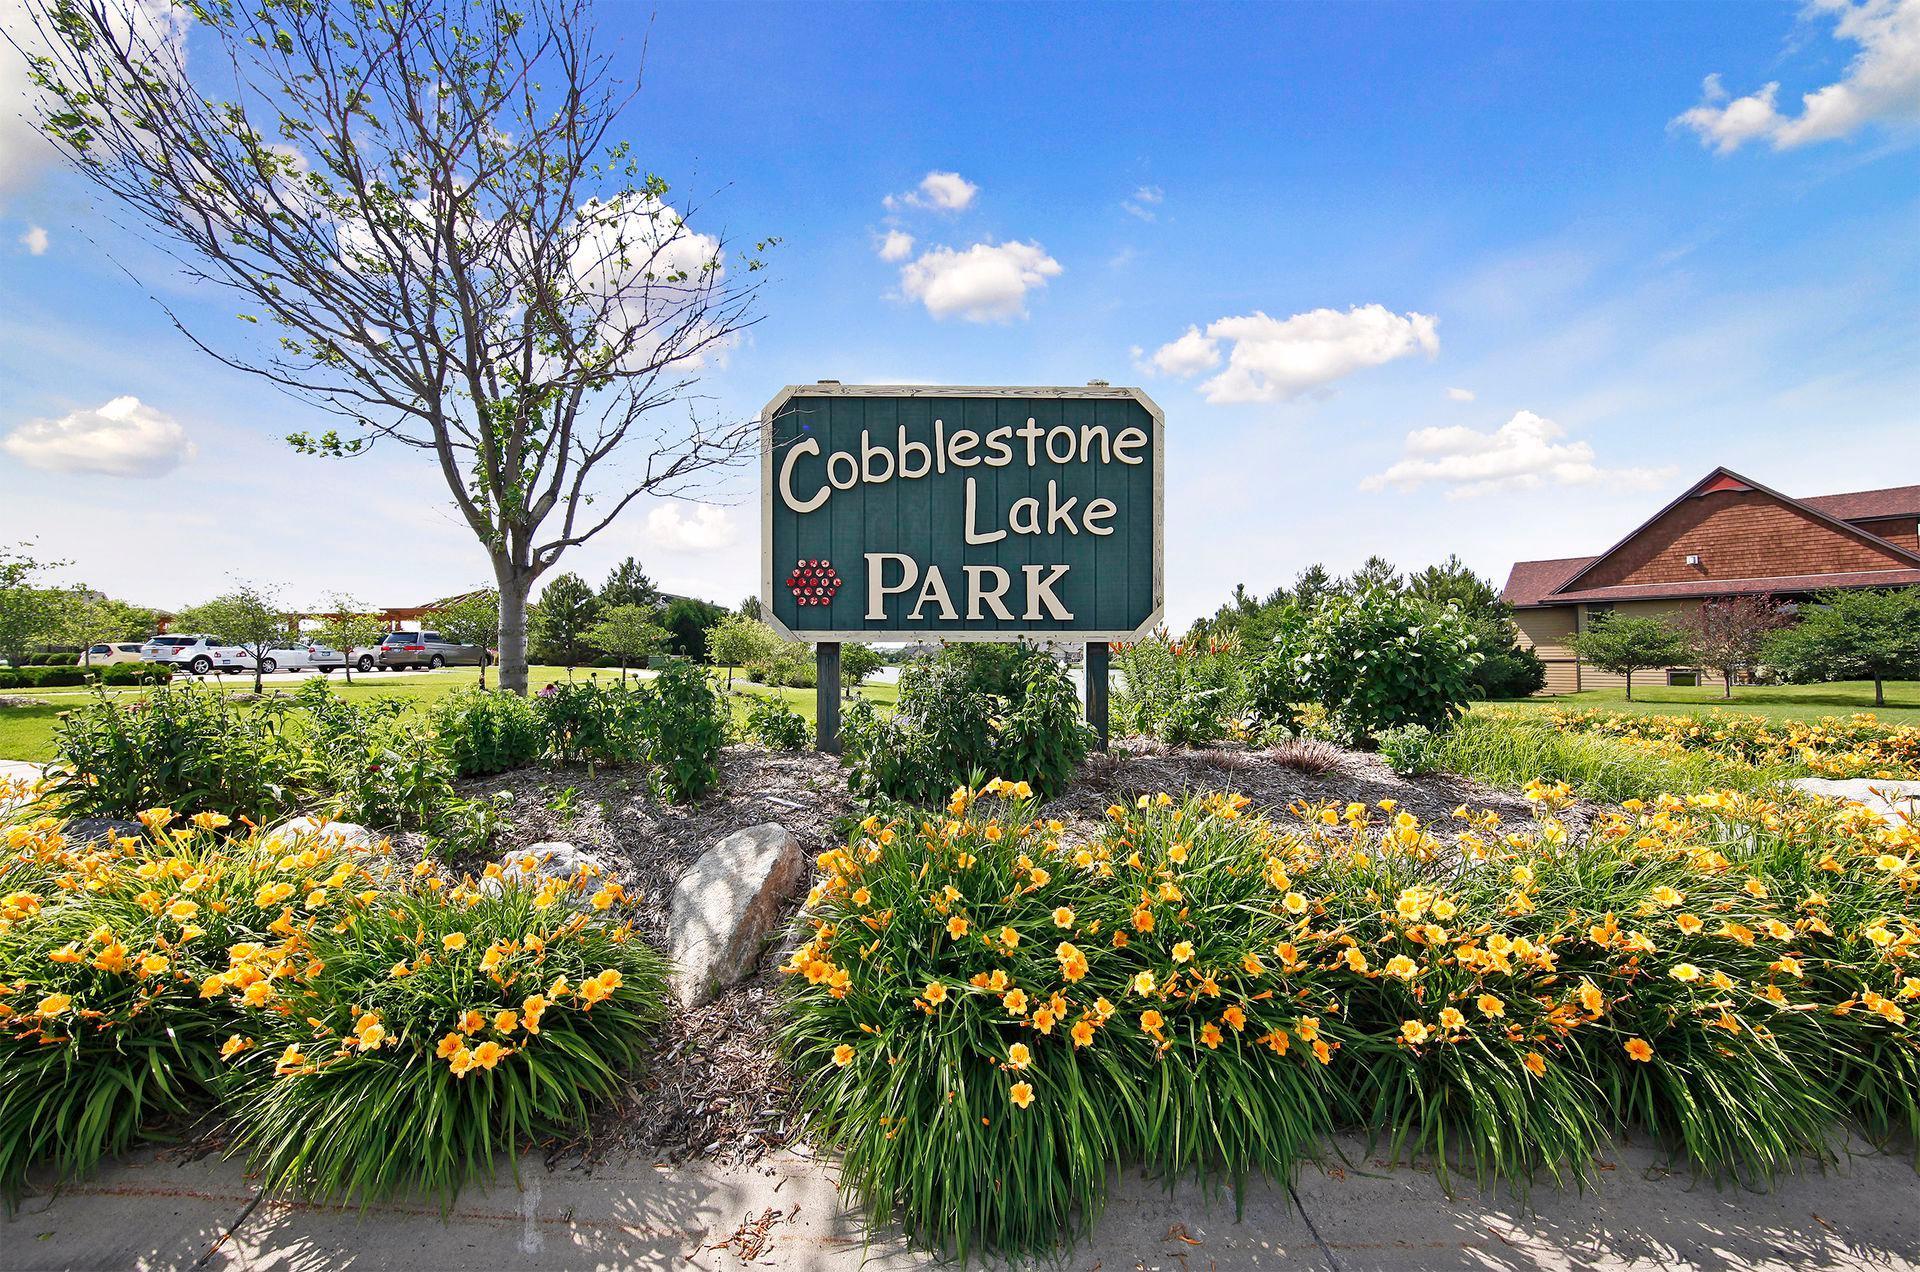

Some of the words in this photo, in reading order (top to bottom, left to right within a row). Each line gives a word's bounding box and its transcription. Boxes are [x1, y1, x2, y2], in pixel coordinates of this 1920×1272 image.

[779, 417, 1148, 513] Cobblestone
[965, 477, 1118, 546] Lake
[864, 552, 1075, 621] PARK
